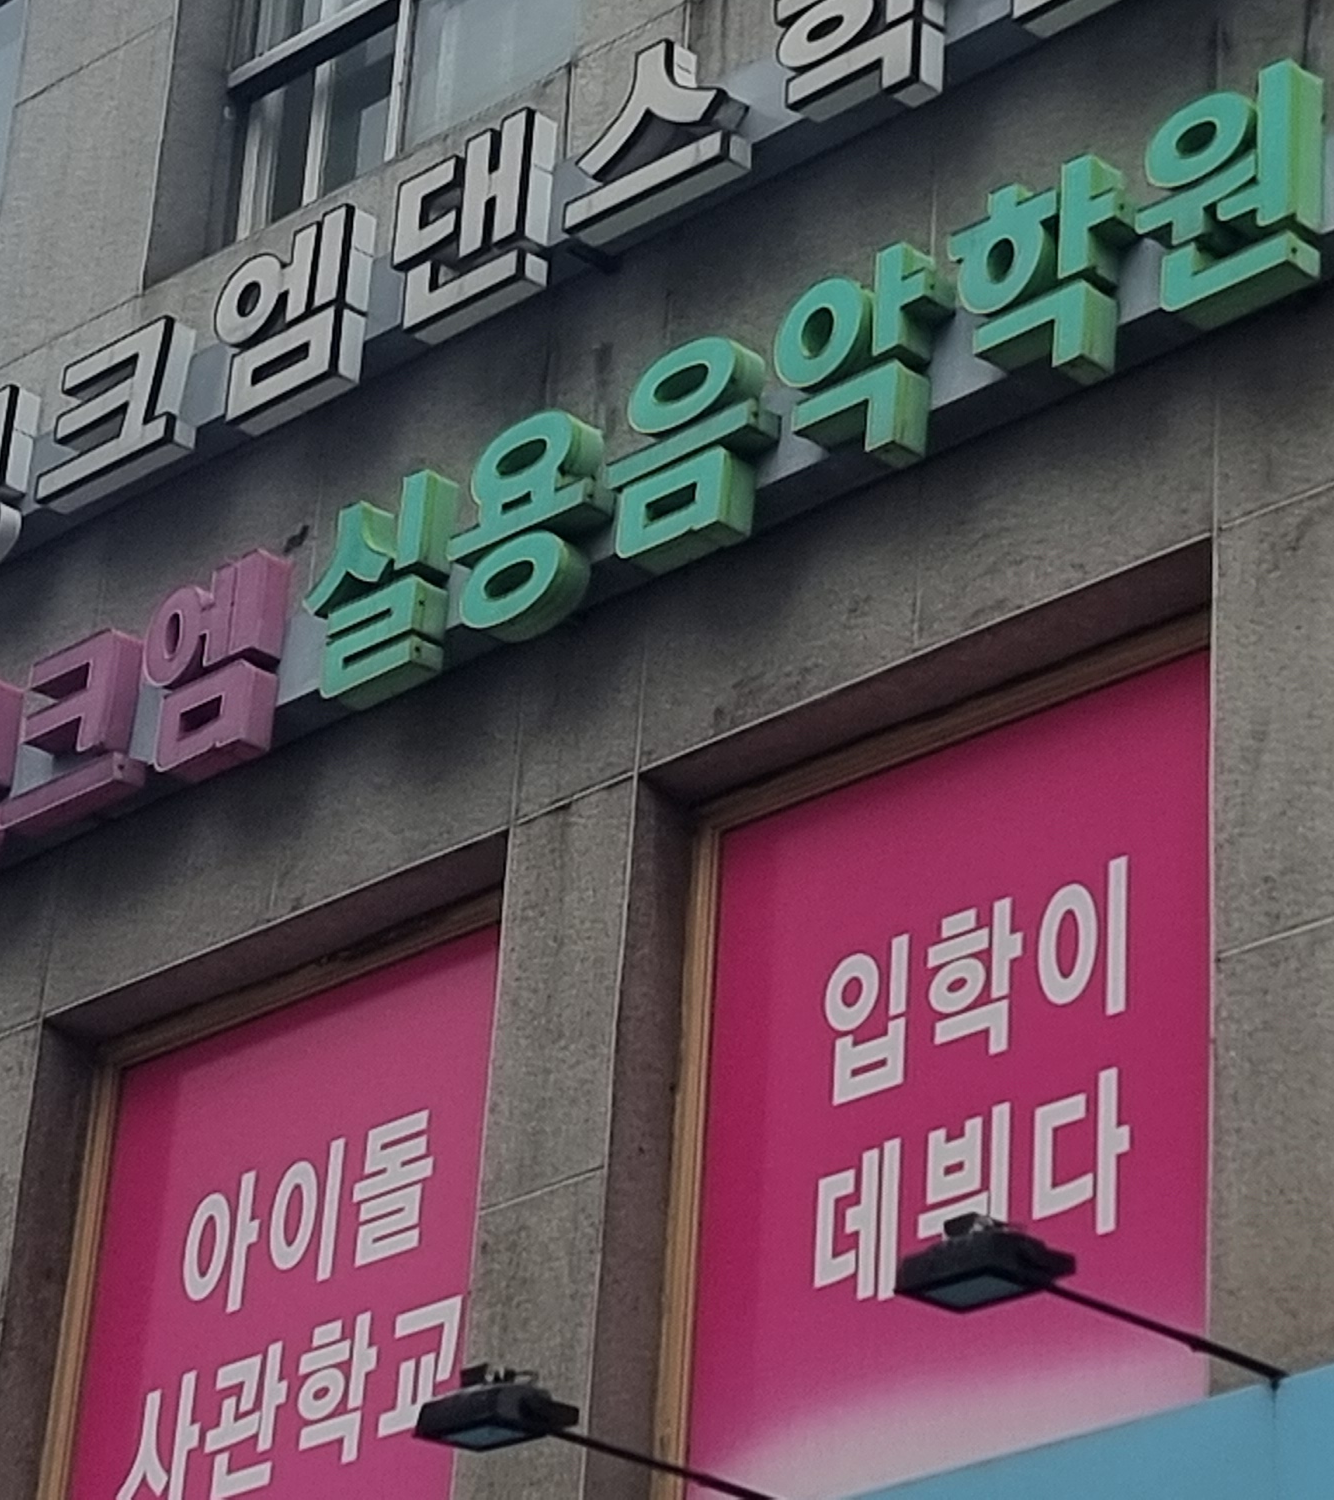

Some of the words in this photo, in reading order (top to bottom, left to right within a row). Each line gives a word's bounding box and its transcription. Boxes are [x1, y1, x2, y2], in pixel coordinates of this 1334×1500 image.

[822, 853, 1130, 1107] 입학이
[181, 1108, 435, 1314] 아이돌
[115, 1294, 464, 1500] 사관학교
